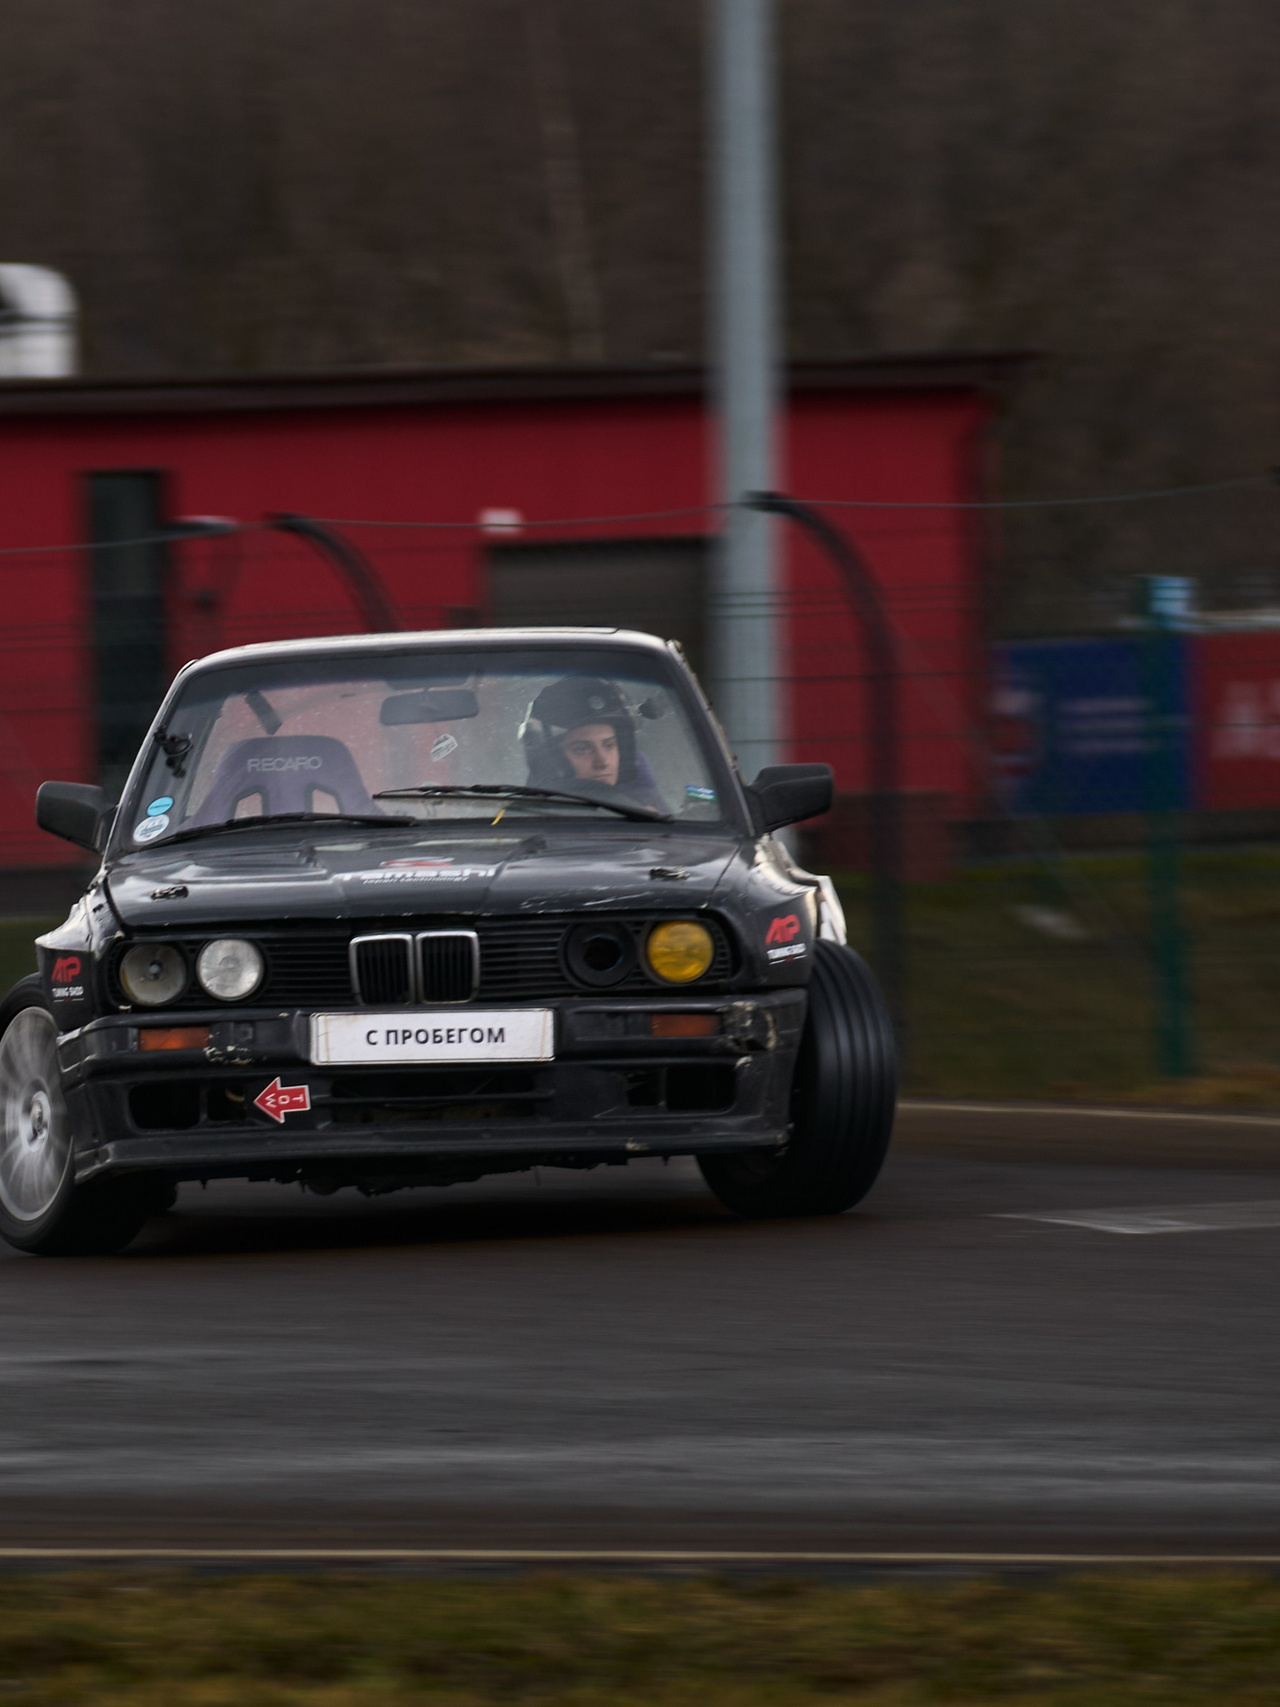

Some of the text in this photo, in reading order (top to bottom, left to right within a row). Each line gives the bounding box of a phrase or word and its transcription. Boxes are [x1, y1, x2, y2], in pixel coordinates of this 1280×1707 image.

[246, 755, 323, 772] RECARO
[366, 1027, 506, 1046] С ПРОБЕГОМ
[264, 1092, 305, 1109] TOW
